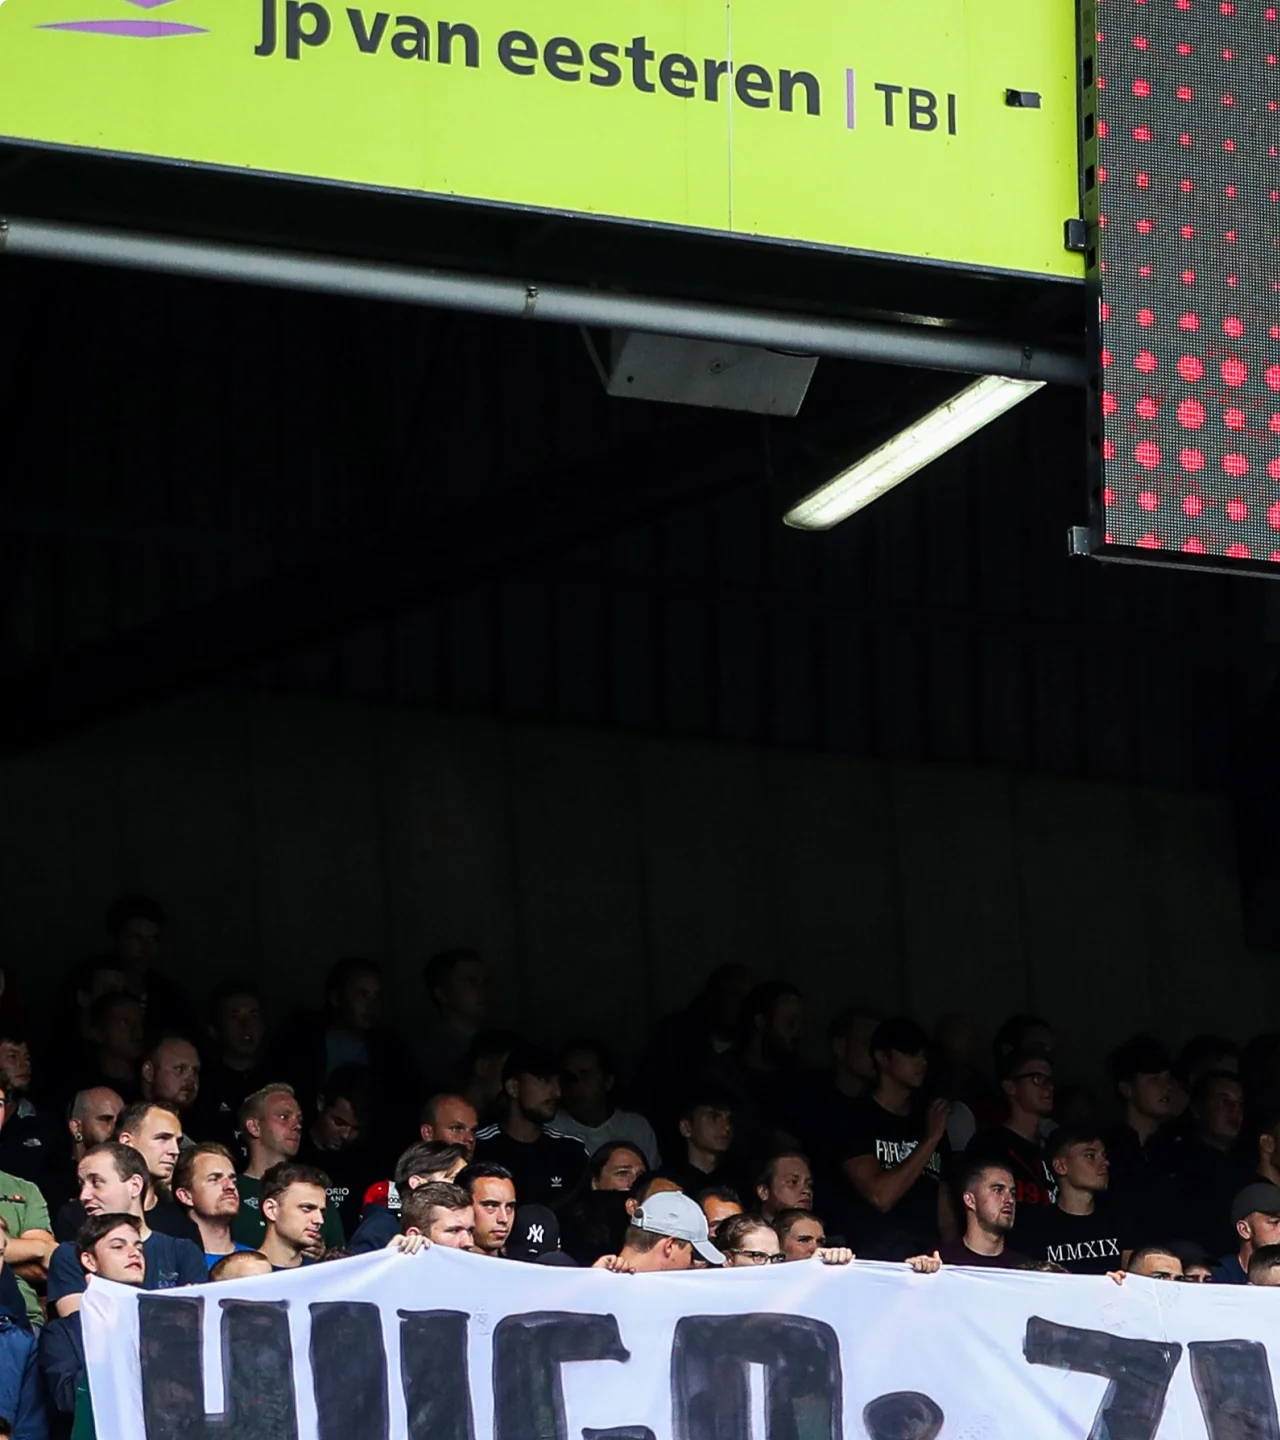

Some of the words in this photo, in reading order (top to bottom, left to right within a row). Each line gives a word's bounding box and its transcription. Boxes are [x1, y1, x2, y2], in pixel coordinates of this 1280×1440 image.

[346, 8, 480, 68] van
[497, 30, 821, 117] eesteren
[874, 82, 957, 136] TBI
[326, 1187, 350, 1196] ORIO
[1046, 1238, 1121, 1262] MMXIX
